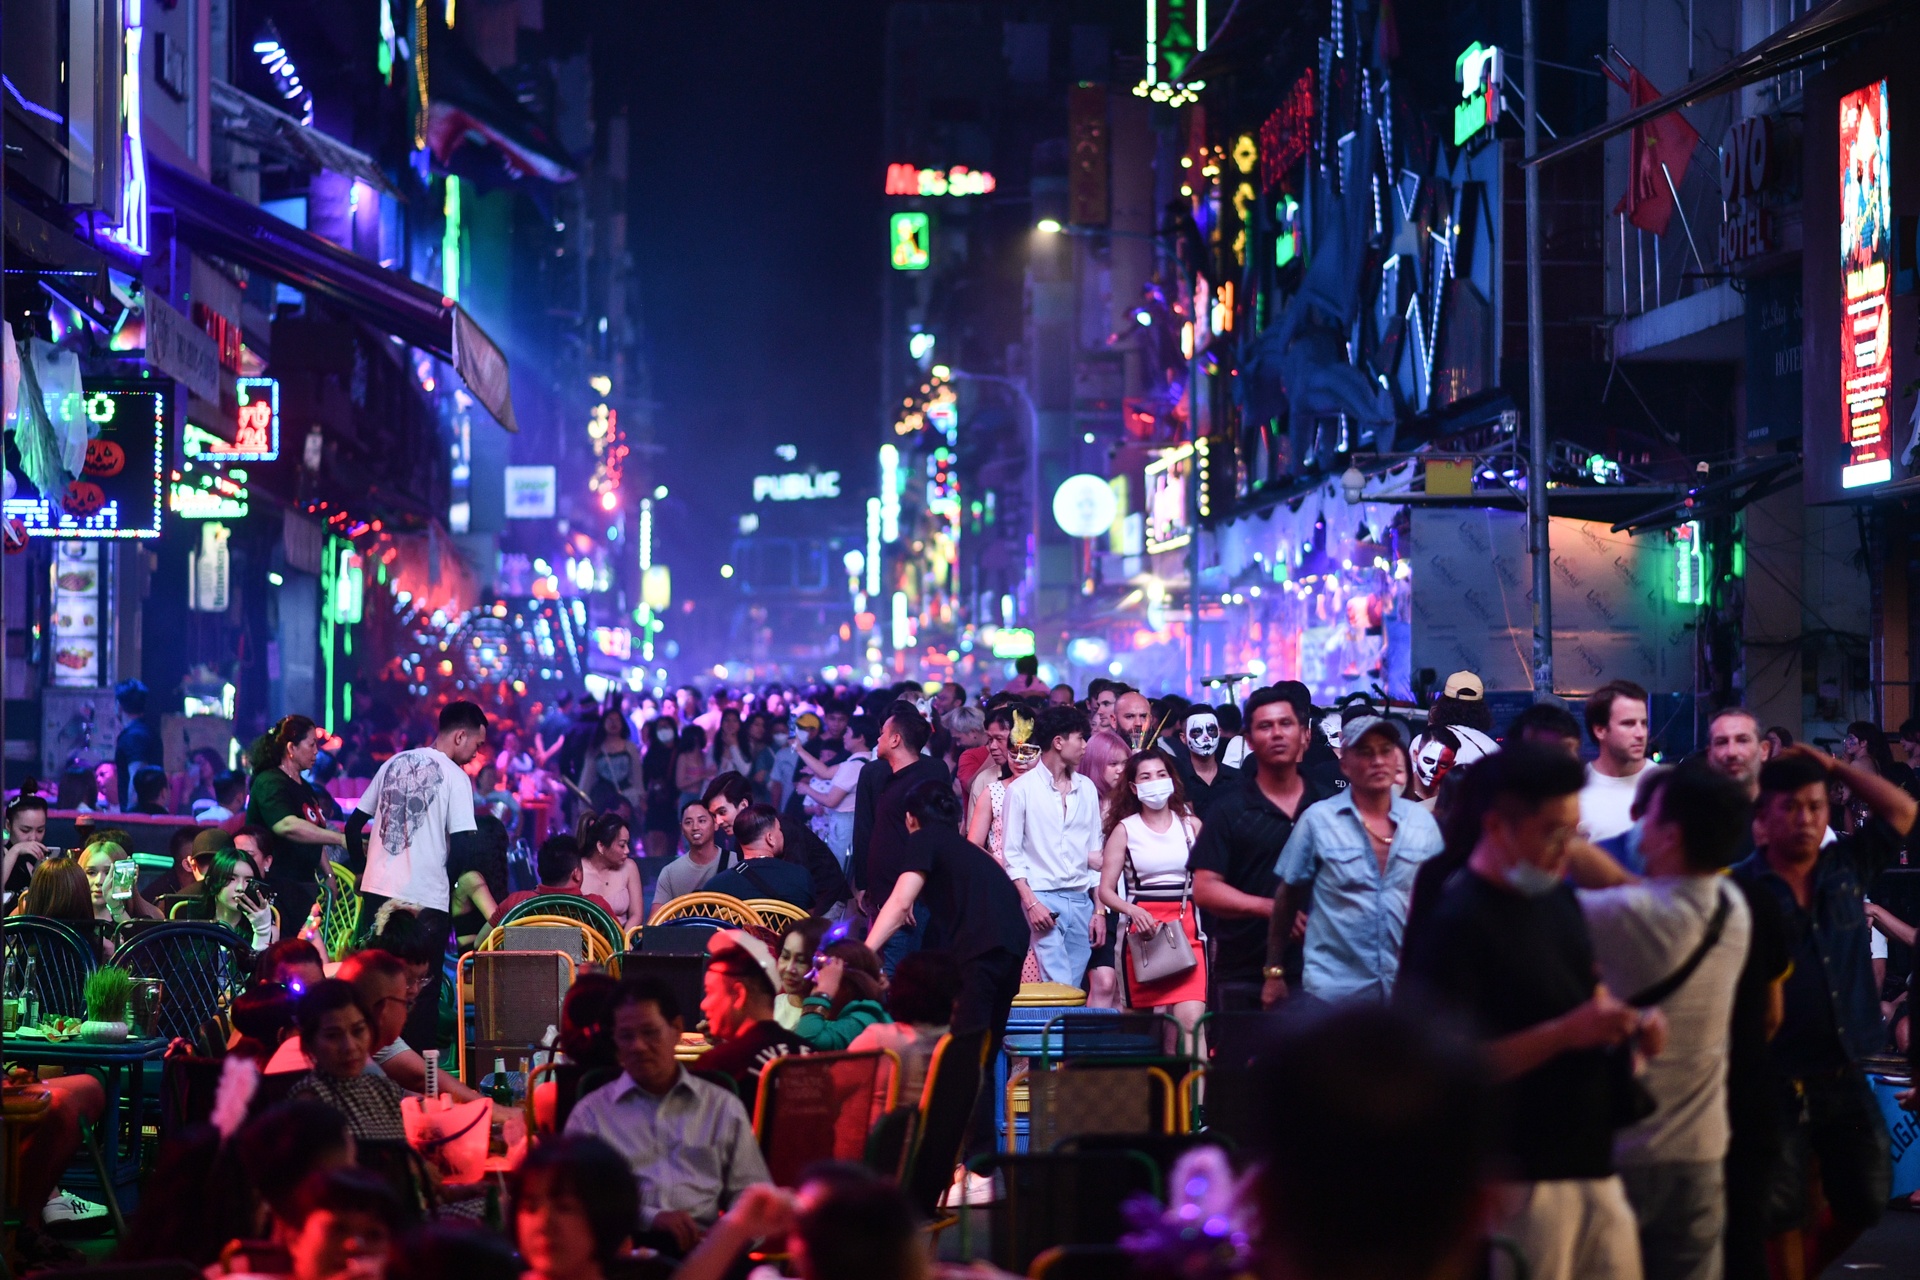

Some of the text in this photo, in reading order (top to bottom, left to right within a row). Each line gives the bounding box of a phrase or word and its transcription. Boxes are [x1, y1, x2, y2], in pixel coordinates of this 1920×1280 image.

[1720, 114, 1768, 201] OYO
[1718, 207, 1768, 266] HOTEL
[753, 471, 840, 502] PUBLIC
